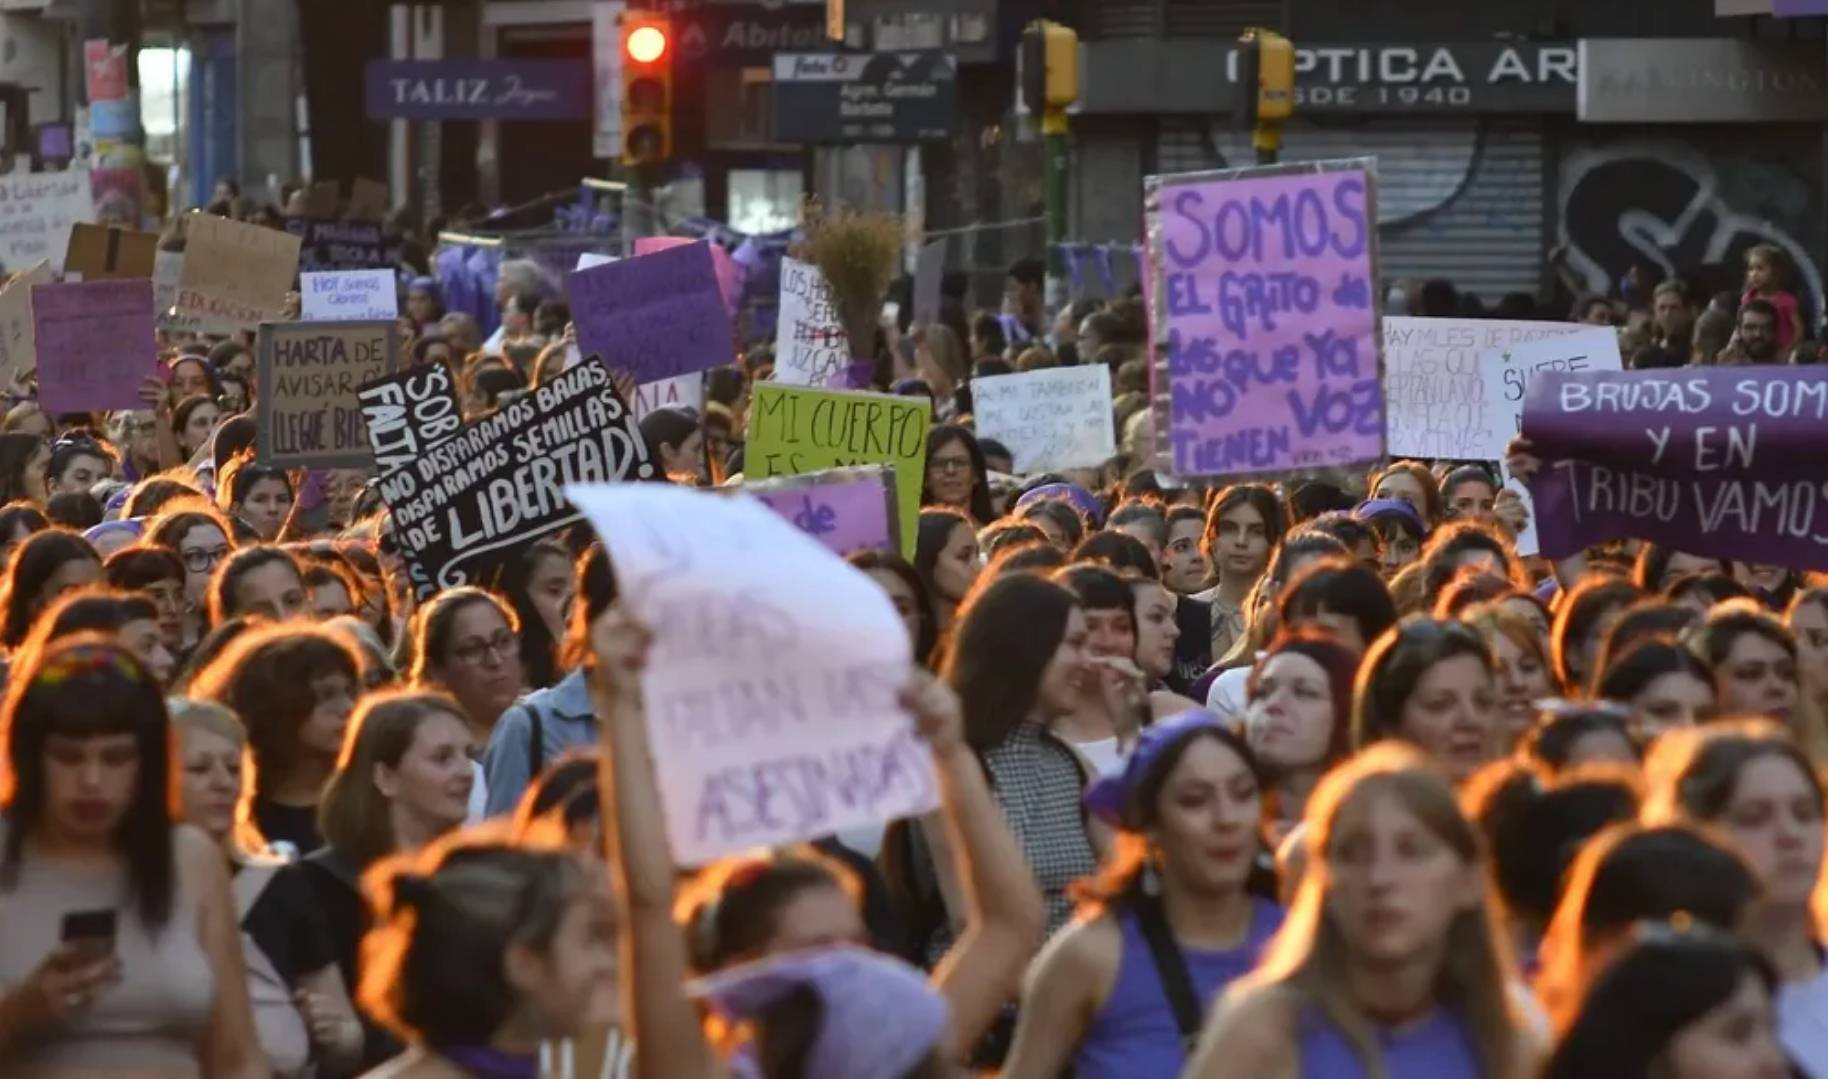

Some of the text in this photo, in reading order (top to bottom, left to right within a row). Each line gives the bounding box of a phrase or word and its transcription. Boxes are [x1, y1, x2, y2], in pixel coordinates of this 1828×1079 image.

[1227, 48, 1464, 83] PTICA
[389, 78, 490, 104] TALIZ
[1379, 85, 1470, 104] 1940
[1165, 179, 1367, 268] SOMOS
[1166, 271, 1211, 317] EL
[274, 336, 384, 366] HARTA DE
[274, 371, 354, 398] AVISAR
[1171, 378, 1236, 424] NO
[1286, 378, 1384, 438] VOZ
[1560, 379, 1712, 413] BRUJAS
[755, 392, 926, 459] MI CUERPO
[1172, 425, 1291, 473] TIENEN
[1645, 423, 1757, 471] Y EN
[380, 474, 416, 505] NO
[417, 398, 535, 483] DISPARAMOS
[396, 388, 623, 527] DISPARAMOS SEMILLAS
[1553, 459, 1680, 523] TRIBU
[406, 515, 442, 552] DE
